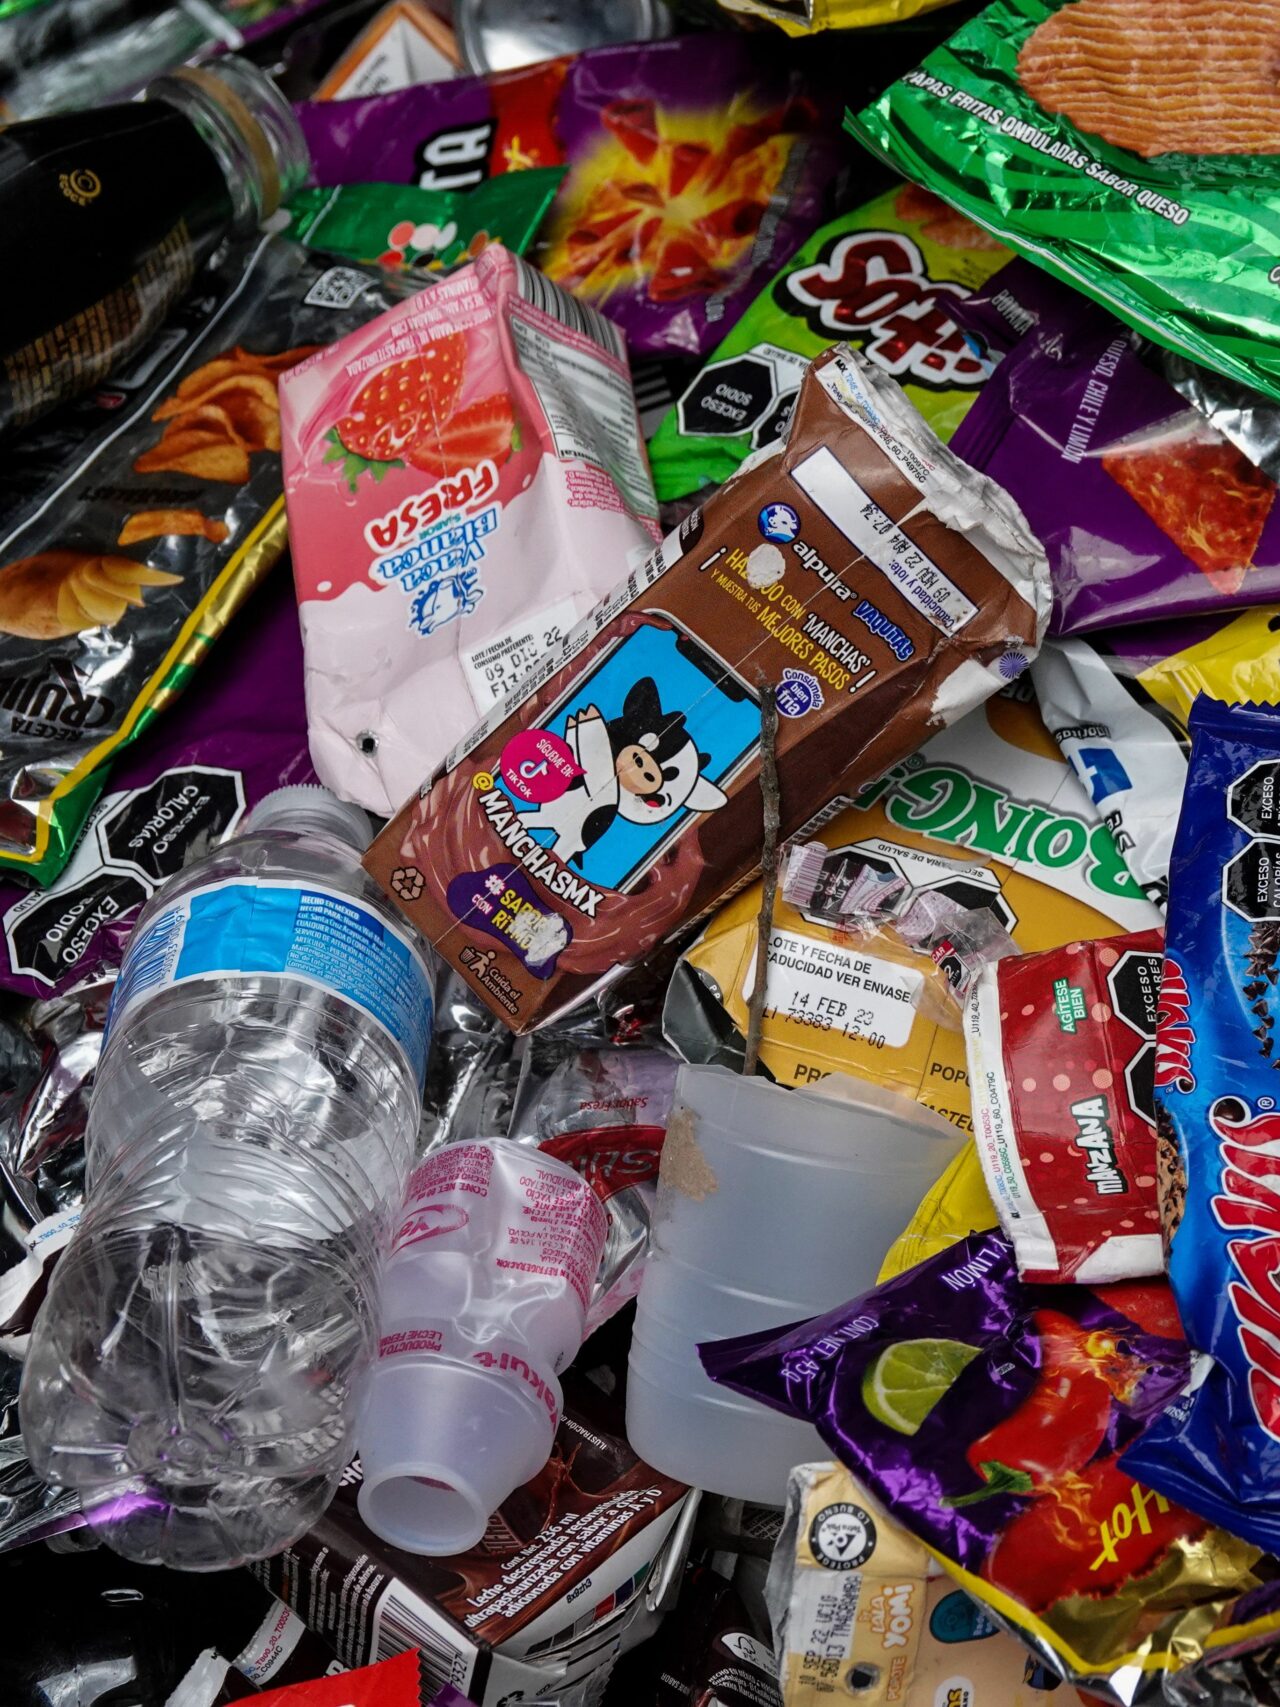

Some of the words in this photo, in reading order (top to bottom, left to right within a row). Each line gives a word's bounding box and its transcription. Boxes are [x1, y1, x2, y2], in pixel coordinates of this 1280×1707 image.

[902, 71, 953, 99] PAPAS
[949, 90, 1004, 125] FRITAS
[1001, 116, 1089, 171] ONDULADAS
[1085, 161, 1138, 198] SABOR
[1136, 189, 1189, 226] QUESO
[991, 289, 1035, 335] BOTANA
[1090, 340, 1127, 377] QUESO,
[700, 396, 747, 421] EXCESO
[715, 383, 753, 406] SODIO
[1079, 379, 1109, 416] CHILE
[1076, 413, 1097, 426] Y
[1061, 422, 1093, 464] LIMÓN
[369, 464, 495, 548] FRESA
[418, 513, 462, 540] SABOR
[379, 508, 498, 579] Blanca
[903, 550, 923, 569] 22
[400, 540, 486, 592] Vaca
[792, 541, 853, 602] alpura
[887, 557, 909, 582] lote:
[716, 573, 746, 602] MUESTRA
[745, 597, 760, 613] TUS
[931, 584, 951, 603] 09
[756, 606, 814, 660] MEJORES
[809, 650, 852, 691] PASOS
[853, 599, 916, 661] VAQUITAS
[483, 661, 505, 682] 09
[540, 625, 563, 647] 22
[776, 689, 802, 717] fría
[783, 668, 824, 709] Consúmela
[789, 683, 809, 704] bien
[536, 738, 566, 770] SÍGUEME
[505, 768, 533, 798] TikTok
[1261, 776, 1275, 820] EXCESO
[472, 772, 604, 917] @MANCHASMX
[877, 843, 906, 859] SALUD
[1258, 857, 1270, 902] EXCESO
[62, 896, 119, 963] EXCESO
[489, 967, 512, 991] Cuida
[800, 944, 809, 956] Y
[811, 947, 852, 969] FECHA
[854, 961, 873, 975] DE
[482, 975, 519, 1016] Ambiente
[792, 990, 810, 1008] 14
[816, 996, 848, 1018] FEB
[853, 1008, 875, 1026] 23
[836, 971, 861, 988] VER
[863, 979, 913, 1004] ENVASE.
[1055, 978, 1076, 1033] AGÍTESE
[1070, 988, 1086, 1019] BIEN
[1137, 964, 1158, 1024] EXCESO
[785, 1007, 834, 1032] 73383
[842, 1022, 887, 1050] 12:00
[1071, 1097, 1124, 1195] MANZANA
[990, 1237, 1013, 1253] Y
[942, 1248, 1000, 1291] LIMÓN
[834, 1315, 879, 1340] CONT.
[817, 1504, 855, 1522] BUENO
[500, 1551, 525, 1573] Cont.
[535, 1520, 563, 1545] 236
[558, 1508, 580, 1528] ml
[462, 1553, 563, 1630] ultrapasteurizada
[556, 1541, 576, 1559] con
[574, 1513, 610, 1544] sabor
[466, 1577, 505, 1611] Leche
[500, 1531, 571, 1586] descremada
[500, 1568, 565, 1619] adicionada
[558, 1550, 584, 1572] con
[576, 1506, 637, 1555] vitaminas
